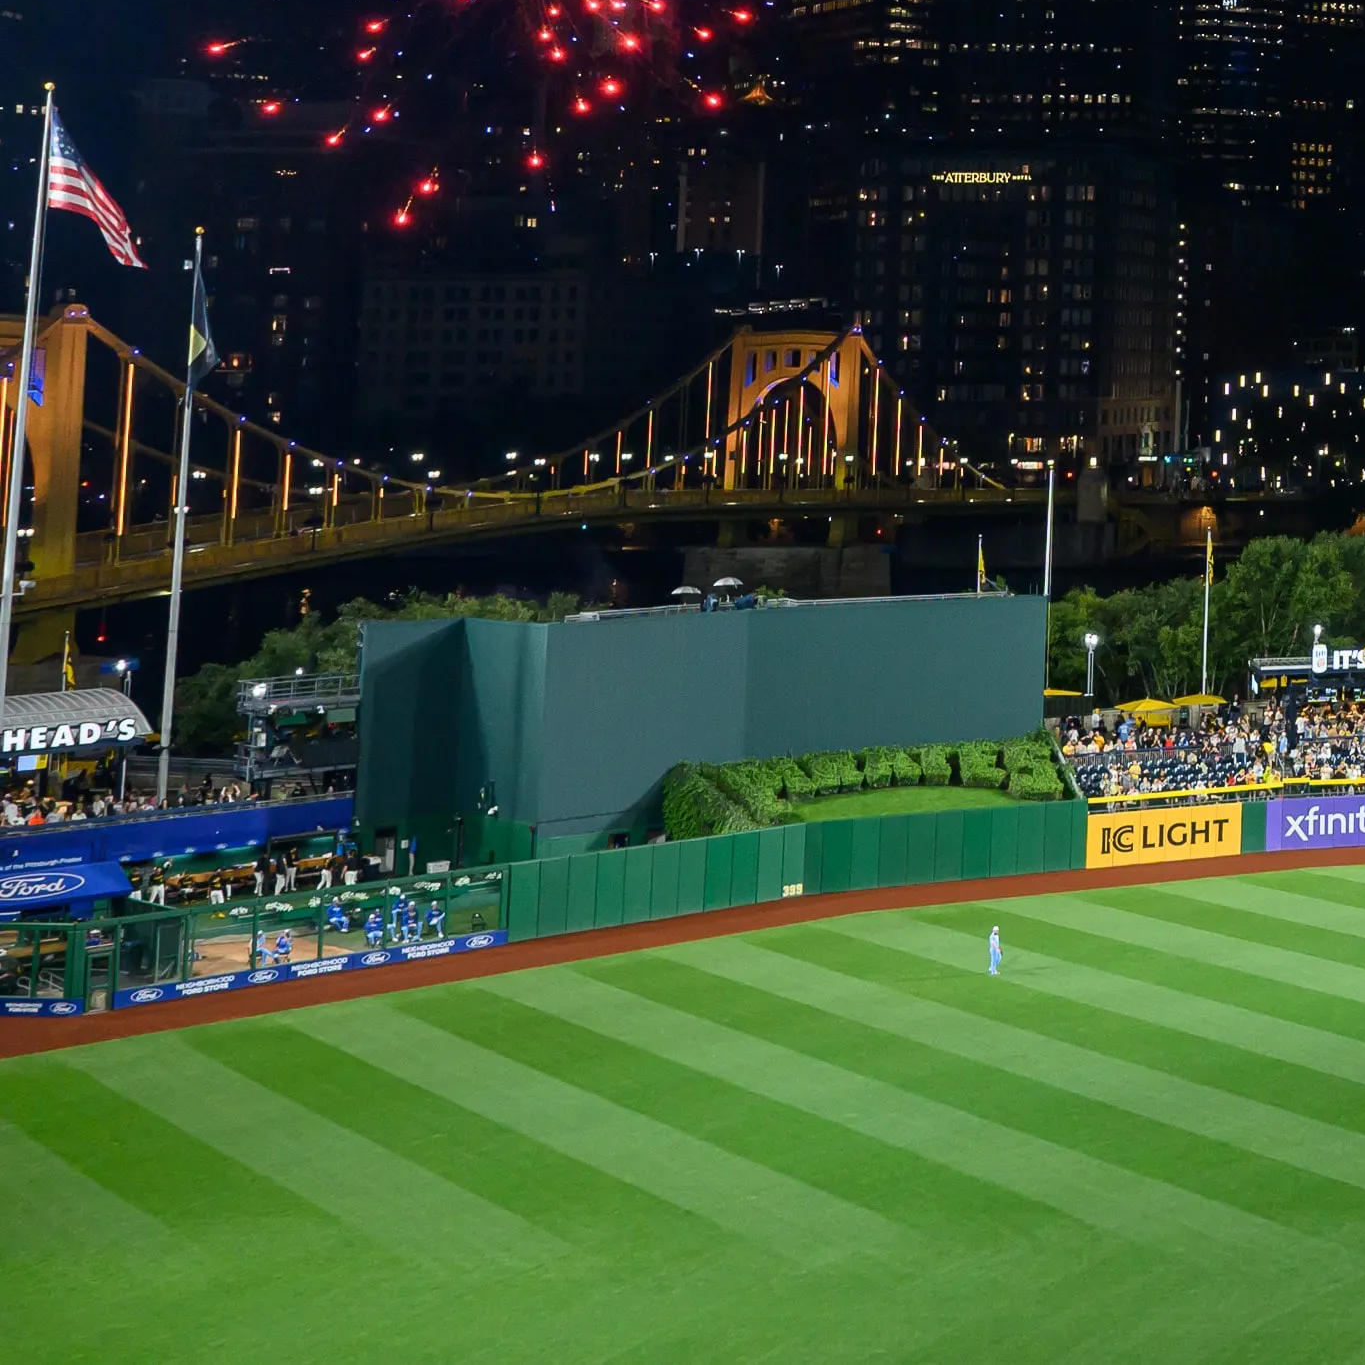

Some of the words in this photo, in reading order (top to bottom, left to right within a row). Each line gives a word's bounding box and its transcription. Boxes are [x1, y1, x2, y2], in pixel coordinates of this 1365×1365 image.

[944, 172, 1011, 183] ATTERBURY
[3, 719, 136, 752] HEAD'S
[1142, 819, 1229, 849] LIGHT
[0, 876, 66, 898] Ford
